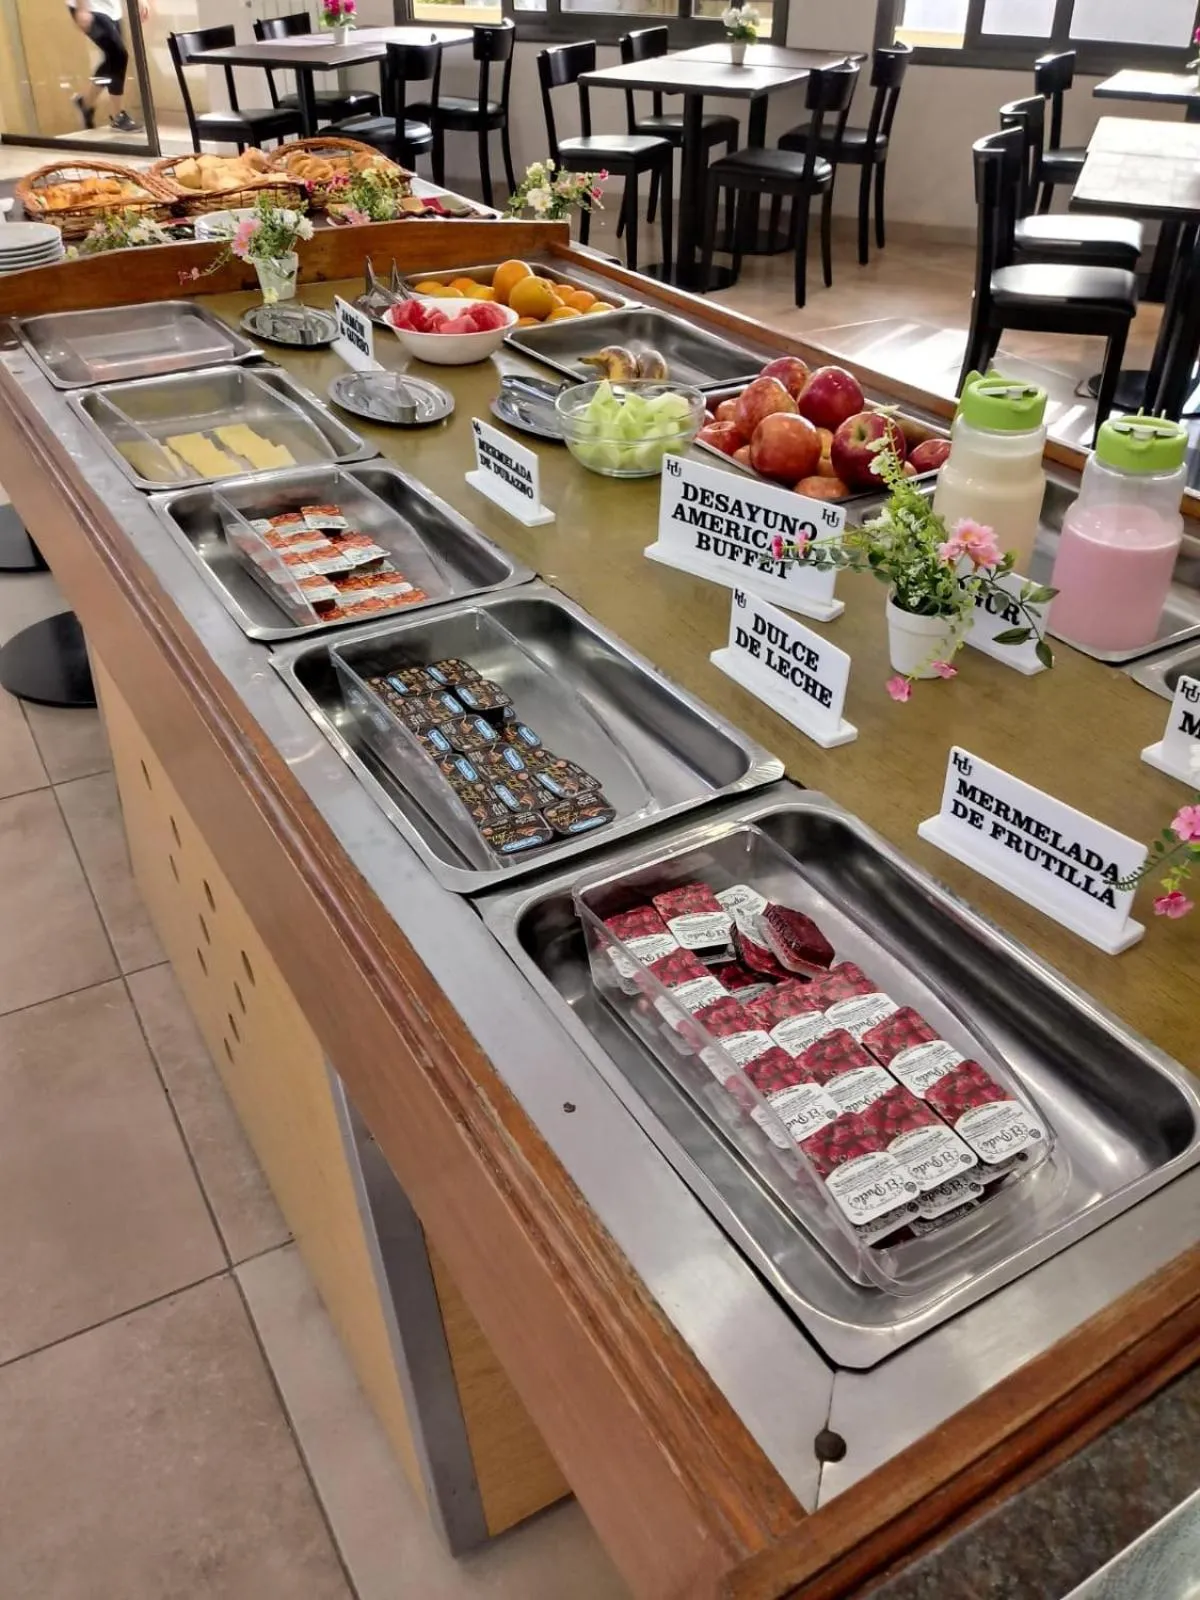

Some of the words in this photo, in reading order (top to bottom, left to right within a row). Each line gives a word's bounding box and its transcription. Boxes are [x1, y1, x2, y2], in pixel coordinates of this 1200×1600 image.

[478, 438, 533, 483] MERMELADA
[479, 453, 492, 470] DE
[493, 462, 534, 499] DURAZNO
[681, 482, 818, 541] DESAYUNO
[696, 532, 788, 579] BUFFET
[735, 627, 761, 658] DE
[765, 648, 833, 709] LECHE
[752, 613, 819, 672] DULCE
[951, 799, 984, 830] DE
[989, 821, 1116, 909] FRUTILLA
[956, 778, 1119, 882] MERMELADA
